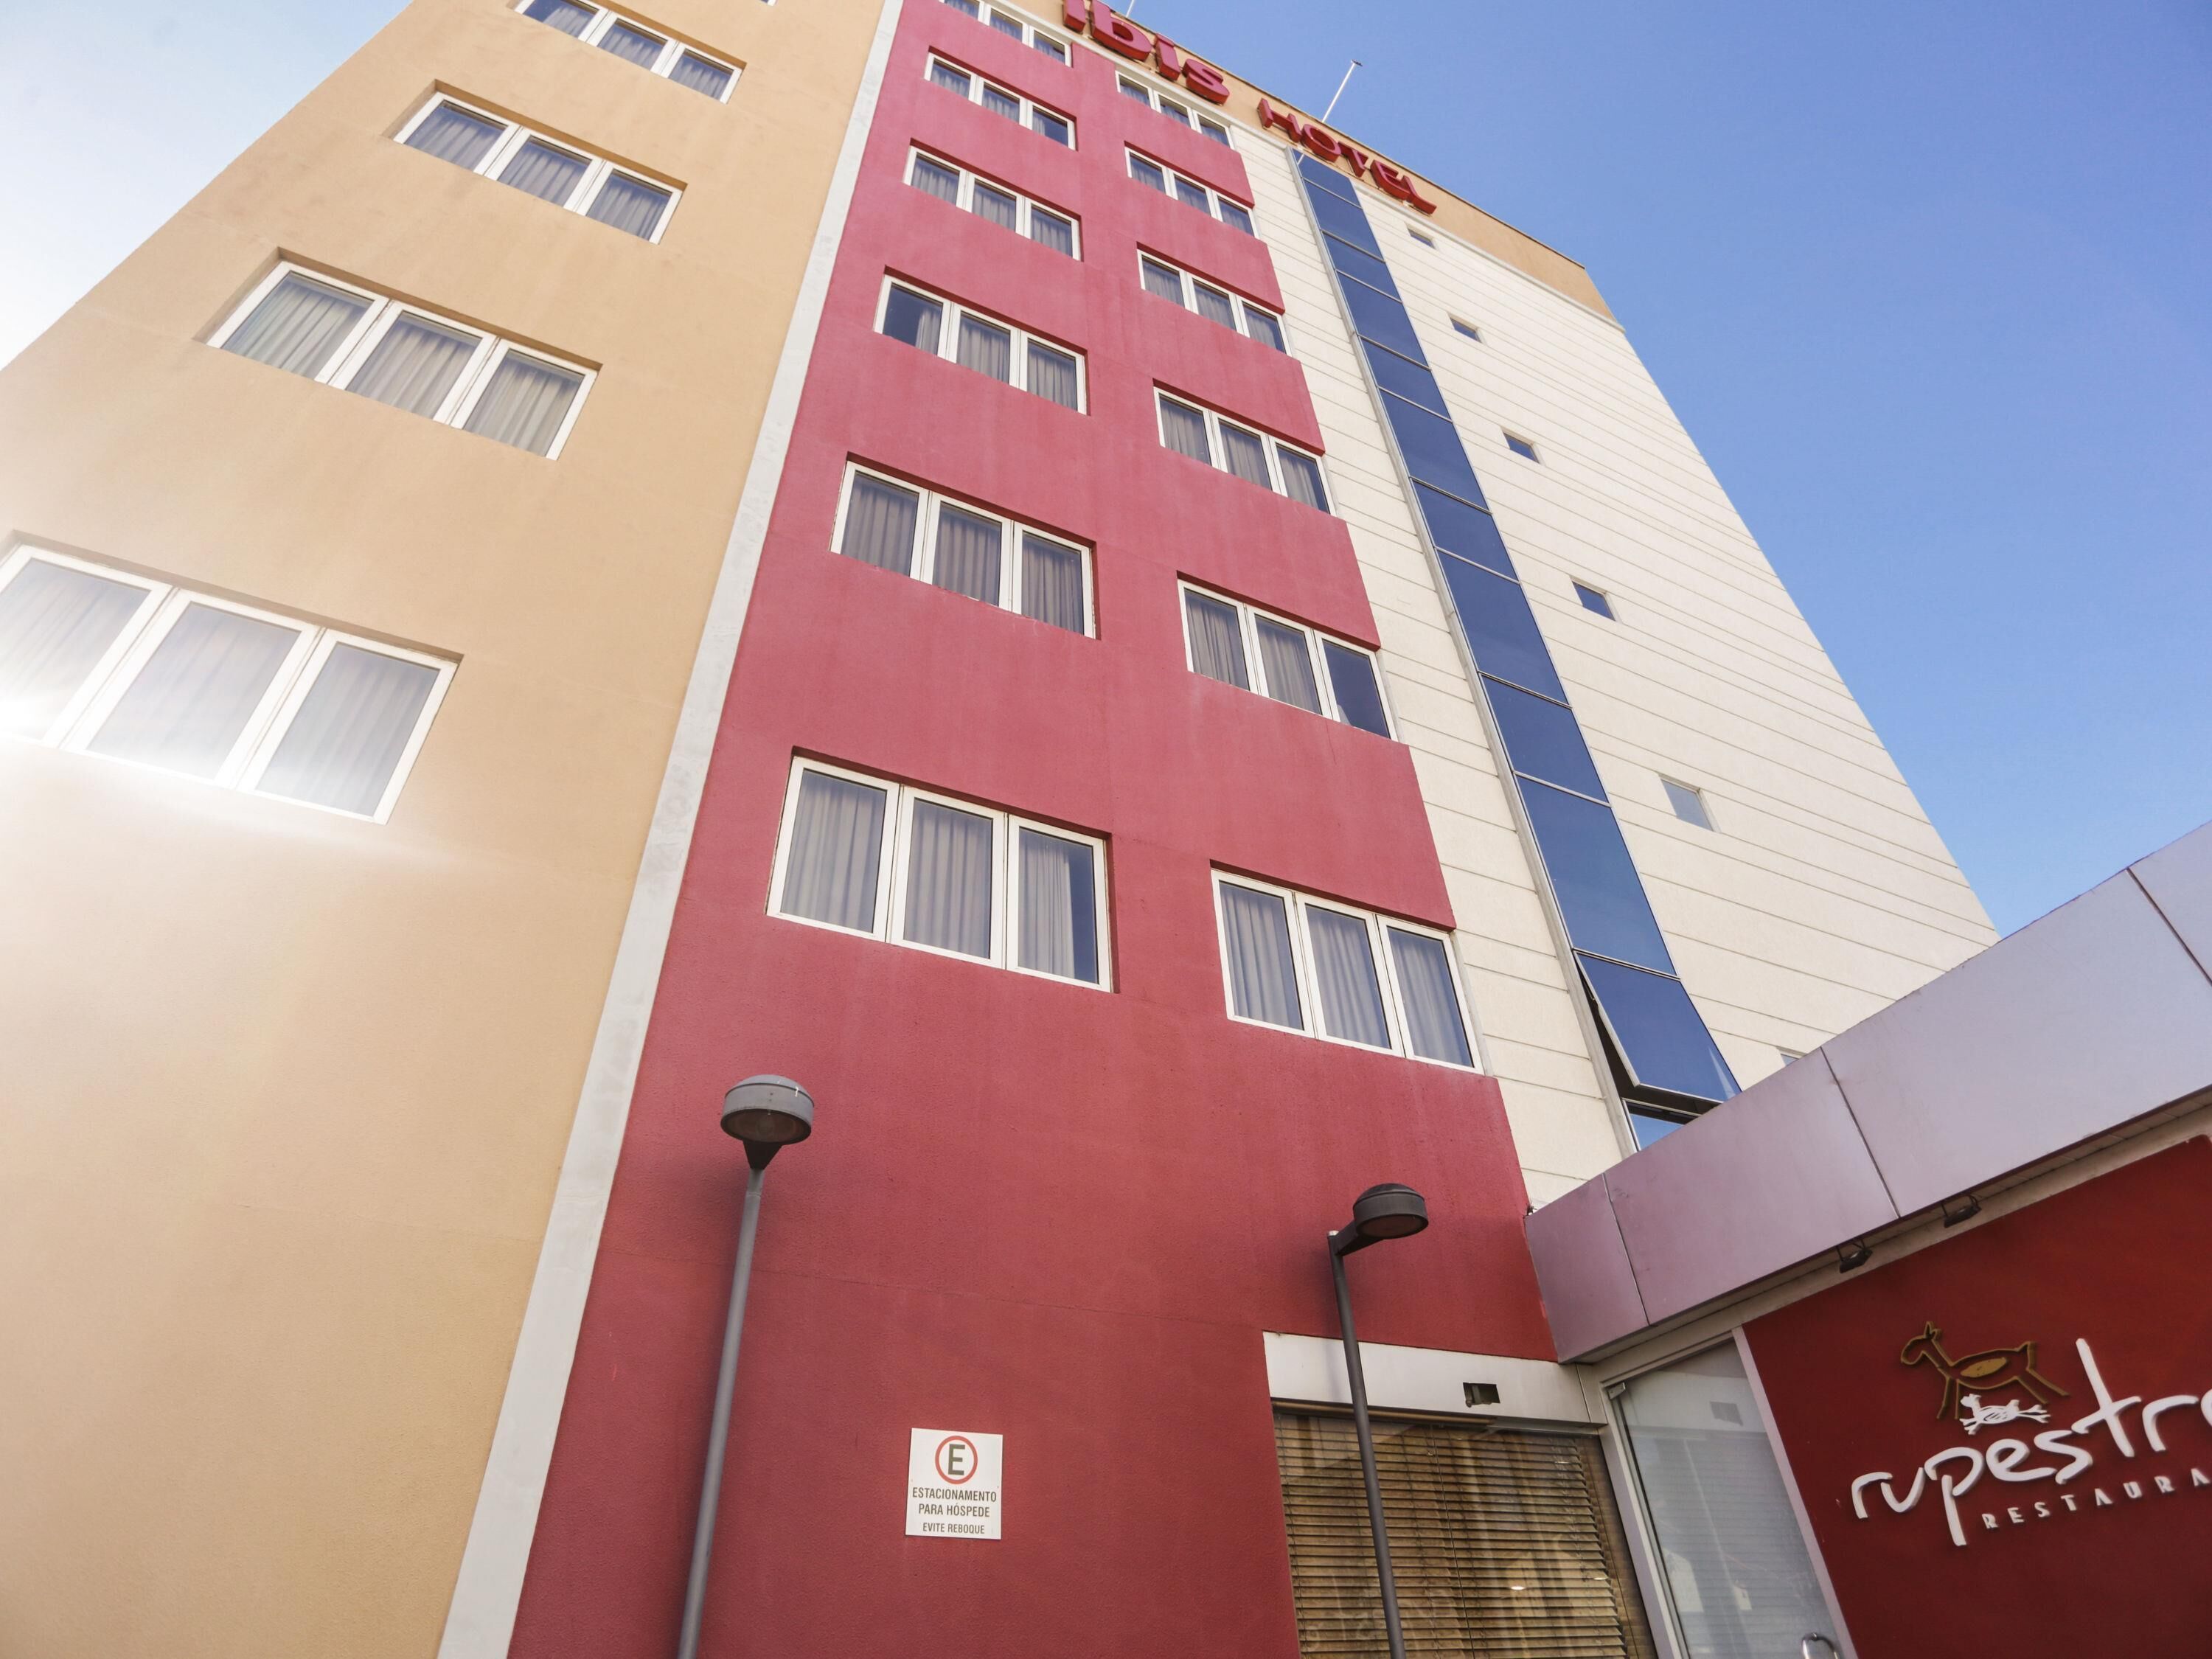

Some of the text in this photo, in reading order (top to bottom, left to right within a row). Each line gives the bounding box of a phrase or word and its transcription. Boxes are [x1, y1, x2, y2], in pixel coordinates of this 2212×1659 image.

[1257, 97, 1437, 215] HOTEL
[1851, 1338, 2212, 1546] rupestr
[947, 1443, 965, 1475] E
[912, 1486, 997, 1503] ESTACIONAMENTO
[918, 1503, 990, 1517] PARA HÓSPEDE
[1982, 1468, 2211, 1529] RESTAURA
[922, 1523, 985, 1534] EVITE REBOQUE
